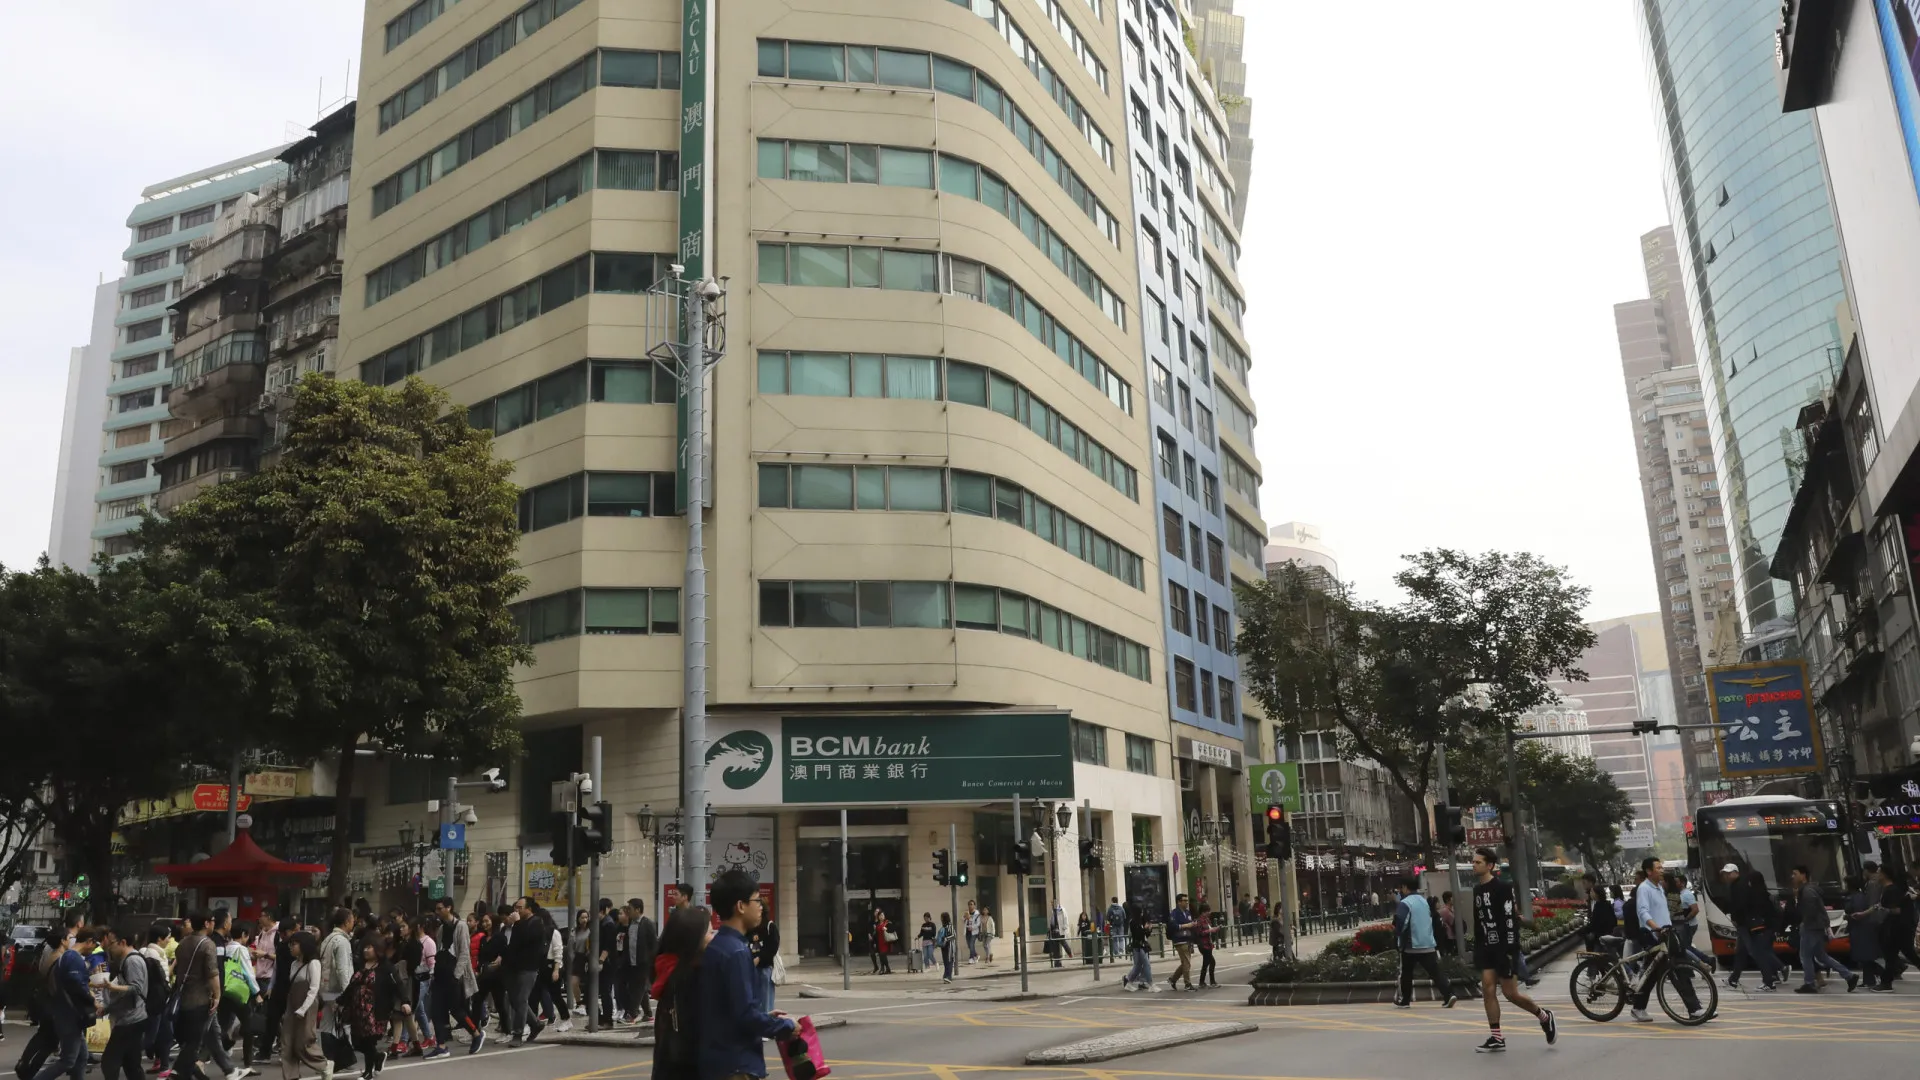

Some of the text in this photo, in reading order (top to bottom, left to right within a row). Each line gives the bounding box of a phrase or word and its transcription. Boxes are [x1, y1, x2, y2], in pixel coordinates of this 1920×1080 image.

[688, 0, 700, 75] ACAU
[1728, 709, 1803, 741] 公主
[789, 763, 929, 780] 澳門商業銀行
[962, 780, 985, 788] Banco
[988, 779, 1024, 787] Comercial
